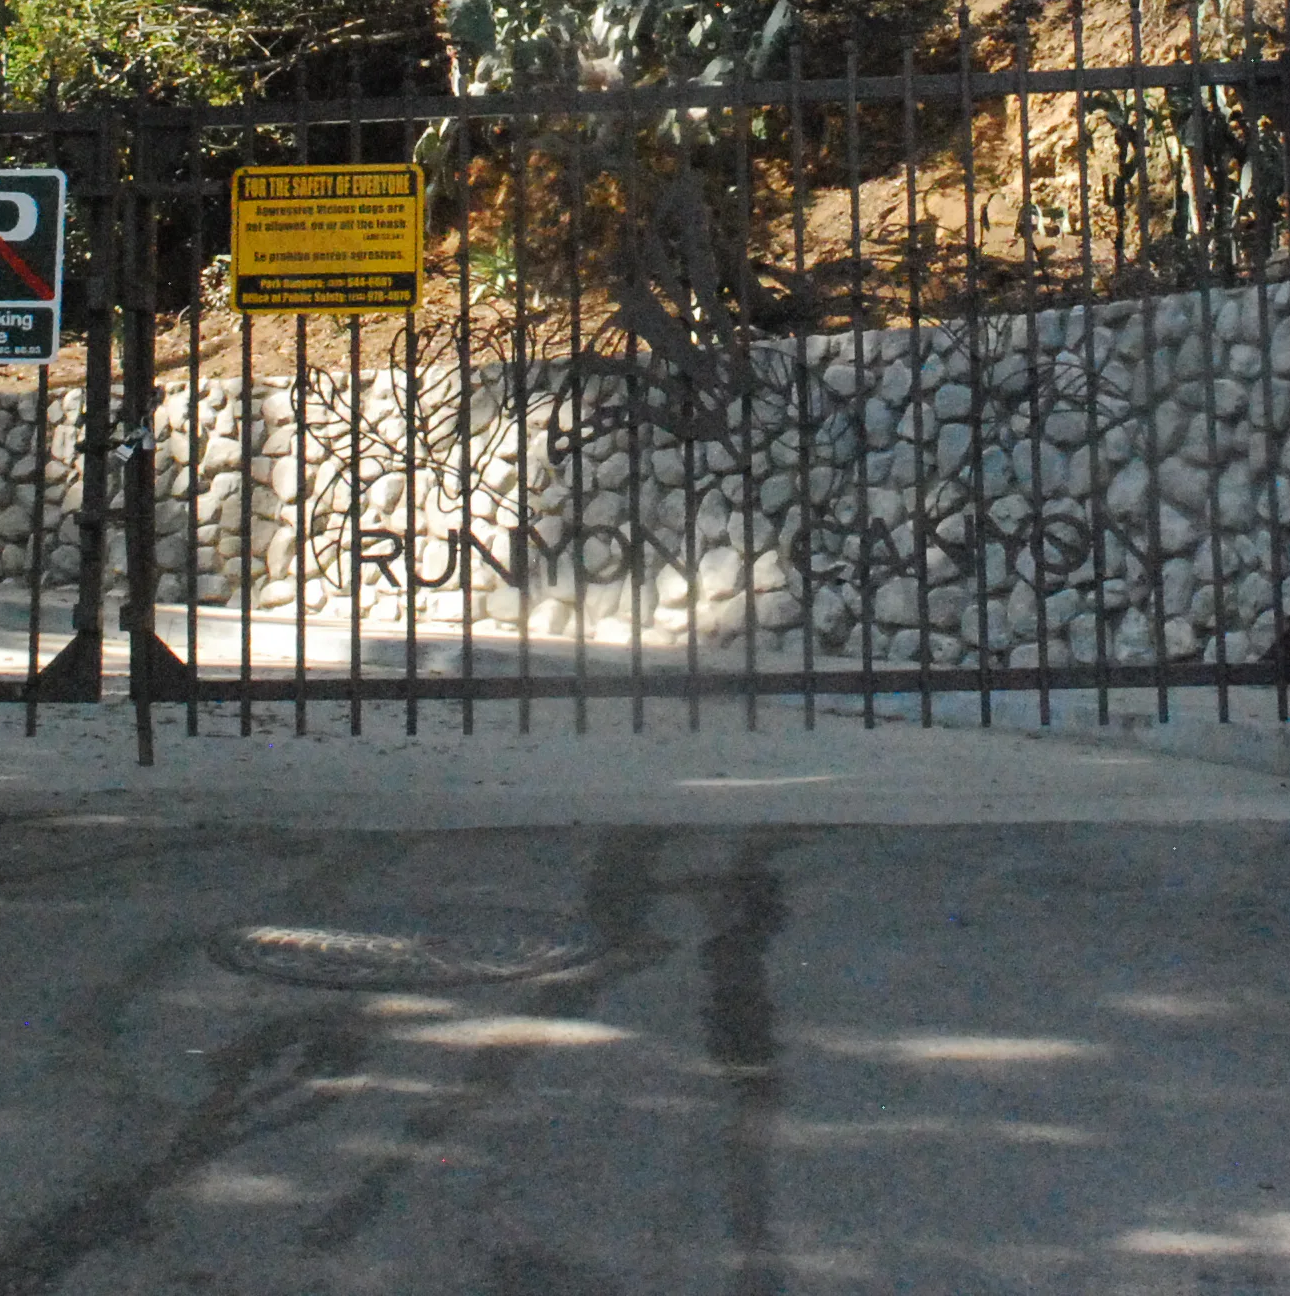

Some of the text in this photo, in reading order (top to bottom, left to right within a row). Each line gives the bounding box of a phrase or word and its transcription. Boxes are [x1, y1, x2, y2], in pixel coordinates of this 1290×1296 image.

[269, 177, 290, 197] THE
[292, 175, 334, 197] SAFETY
[336, 175, 351, 196] OF
